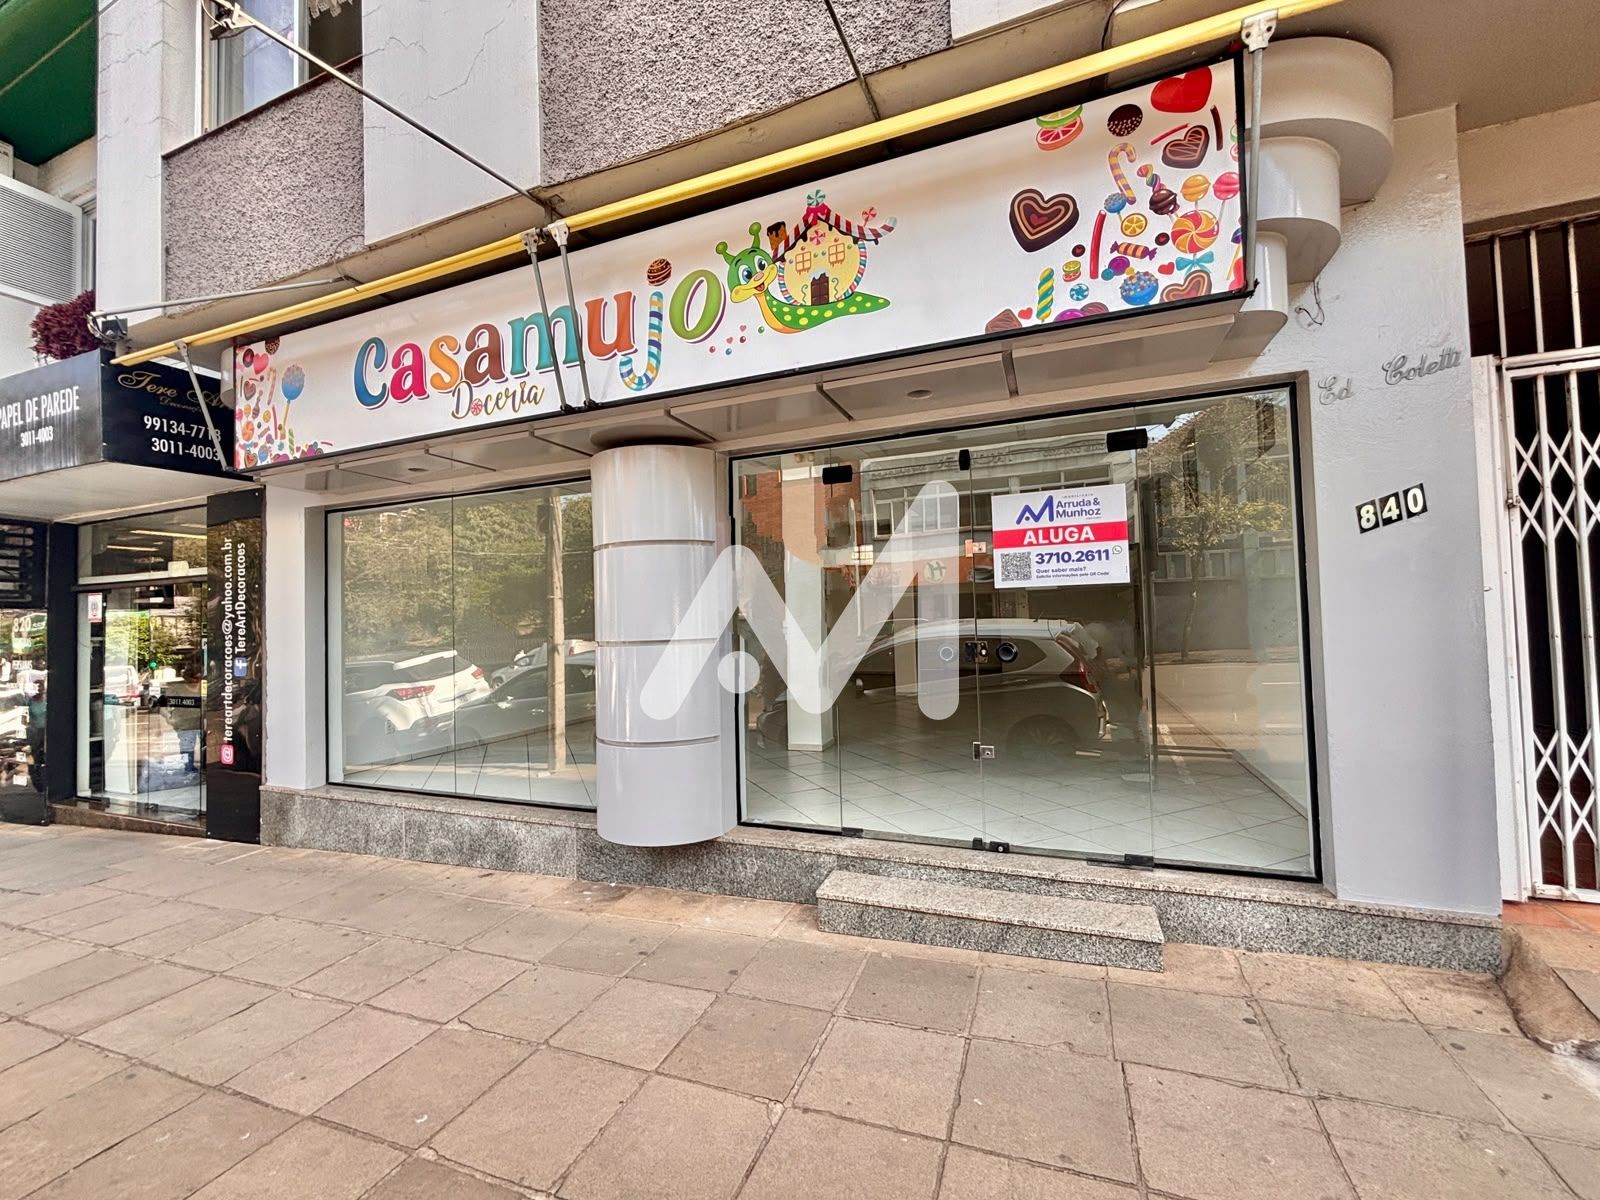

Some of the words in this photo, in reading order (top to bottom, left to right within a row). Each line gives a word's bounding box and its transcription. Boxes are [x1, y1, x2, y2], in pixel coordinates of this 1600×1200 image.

[354, 258, 726, 410] Casamujo
[118, 371, 178, 397] Tere
[1318, 376, 1353, 405] Ed
[25, 397, 39, 423] DE
[41, 386, 80, 418] PAREDE
[451, 380, 545, 420] Doceria
[20, 426, 53, 447] 3011-4003
[151, 437, 221, 461] 3011-4003
[1056, 499, 1092, 509] Arruda
[1093, 497, 1101, 506] &
[1056, 508, 1102, 518] Munhoz
[1359, 487, 1425, 530] 840
[1023, 526, 1095, 545] ALUGA
[1035, 549, 1110, 564] 3710.2611
[234, 542, 246, 654] TereArtDecoracoes
[220, 537, 235, 742] tereartdecoracoes@yahoo.com.br
